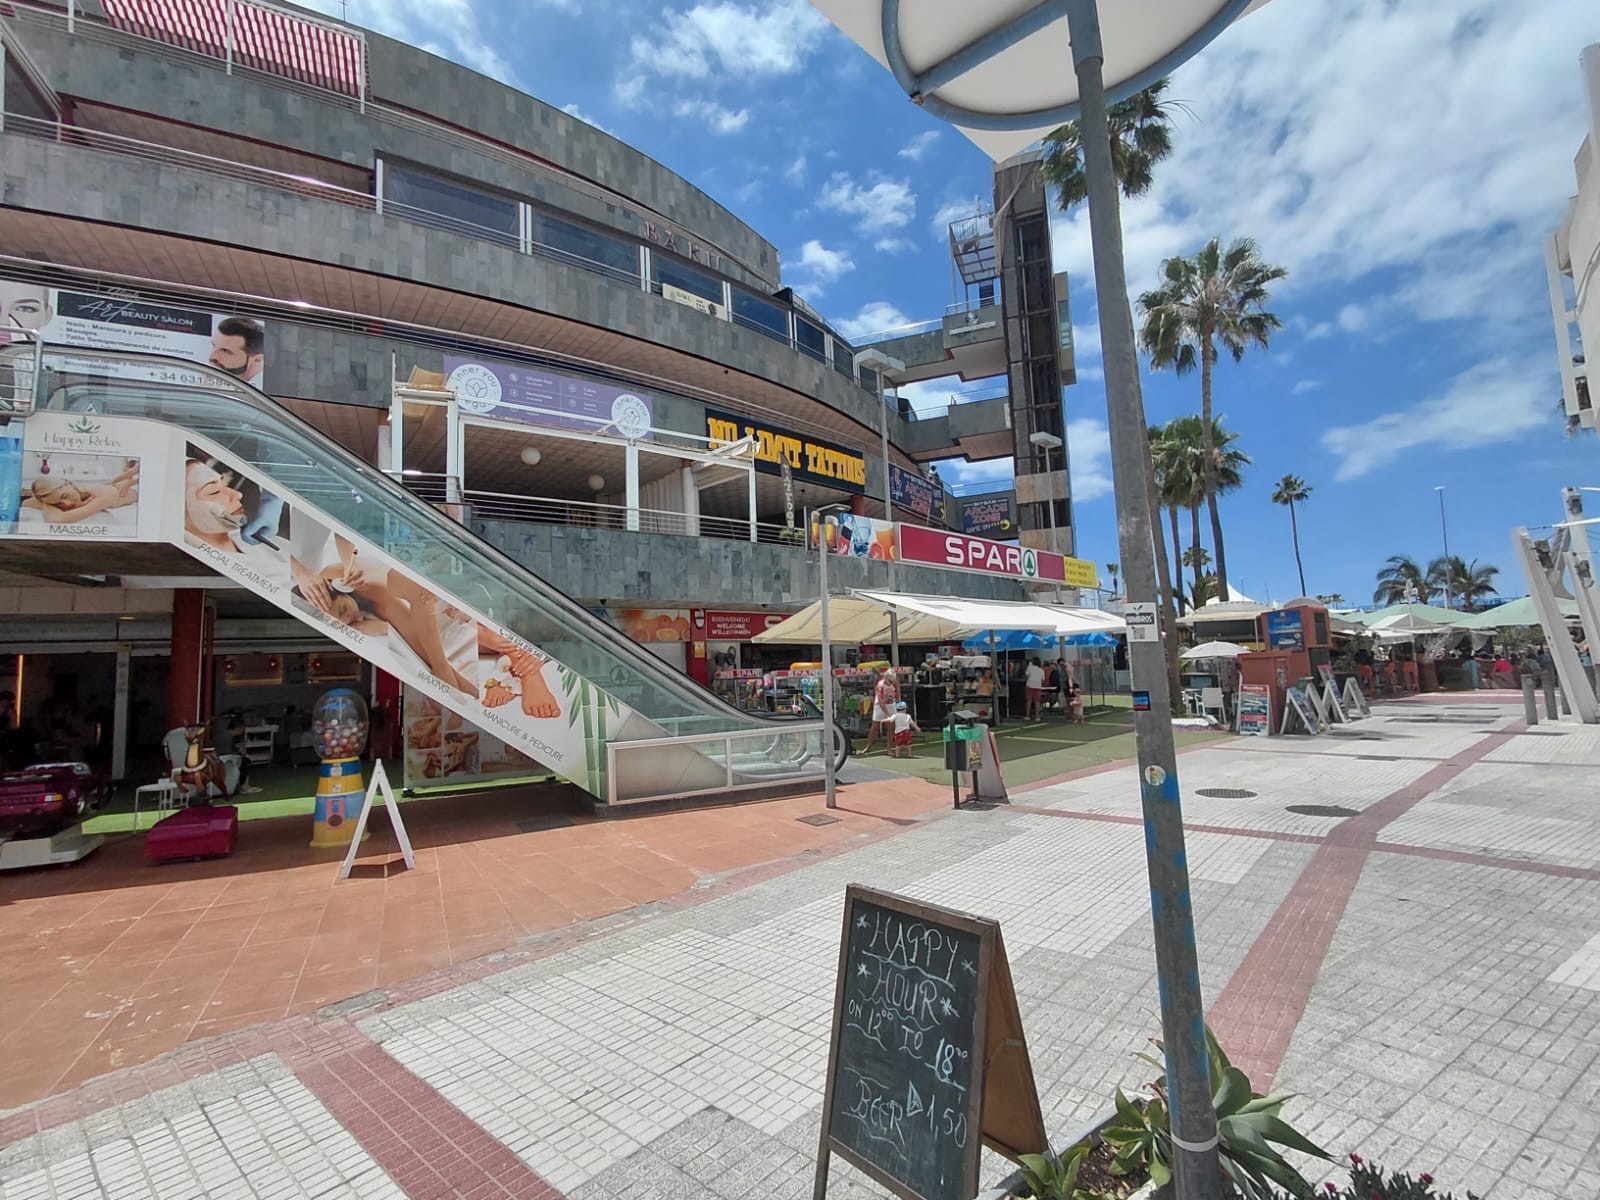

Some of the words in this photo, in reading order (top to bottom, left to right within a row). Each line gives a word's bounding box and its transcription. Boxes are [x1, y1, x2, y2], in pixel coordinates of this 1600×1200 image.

[78, 300, 137, 322] Art
[121, 310, 159, 322] BEAUTY
[160, 315, 194, 326] SALON
[160, 371, 177, 381] 34
[180, 373, 203, 385] 631
[455, 367, 479, 382] inner
[482, 370, 498, 388] you
[636, 401, 649, 416] you
[44, 432, 84, 448] Happy
[88, 435, 122, 448] Relax
[707, 417, 738, 449] NO
[744, 426, 802, 469] IMIT
[805, 442, 866, 486] TATTOOS
[964, 503, 1008, 517] ARCADE
[972, 512, 1001, 525] ZONE
[49, 525, 109, 535] MASSAGE
[945, 536, 1021, 575] SPAR
[199, 542, 231, 567] FACIAL
[232, 561, 281, 595] TREATMENT
[332, 620, 366, 645] CANDLE
[417, 669, 450, 694] WAXING
[791, 670, 814, 678] SPAR
[847, 668, 867, 676] SPAR
[481, 708, 522, 737] MANICURE
[521, 732, 528, 741] &
[529, 736, 566, 762] PEDICURE
[870, 911, 959, 982] HAPPY
[871, 961, 942, 1025] HOUR
[848, 999, 862, 1018] ON
[901, 1025, 924, 1050] TO
[850, 1078, 905, 1145] BEER
[927, 1093, 968, 1149] 1,50
